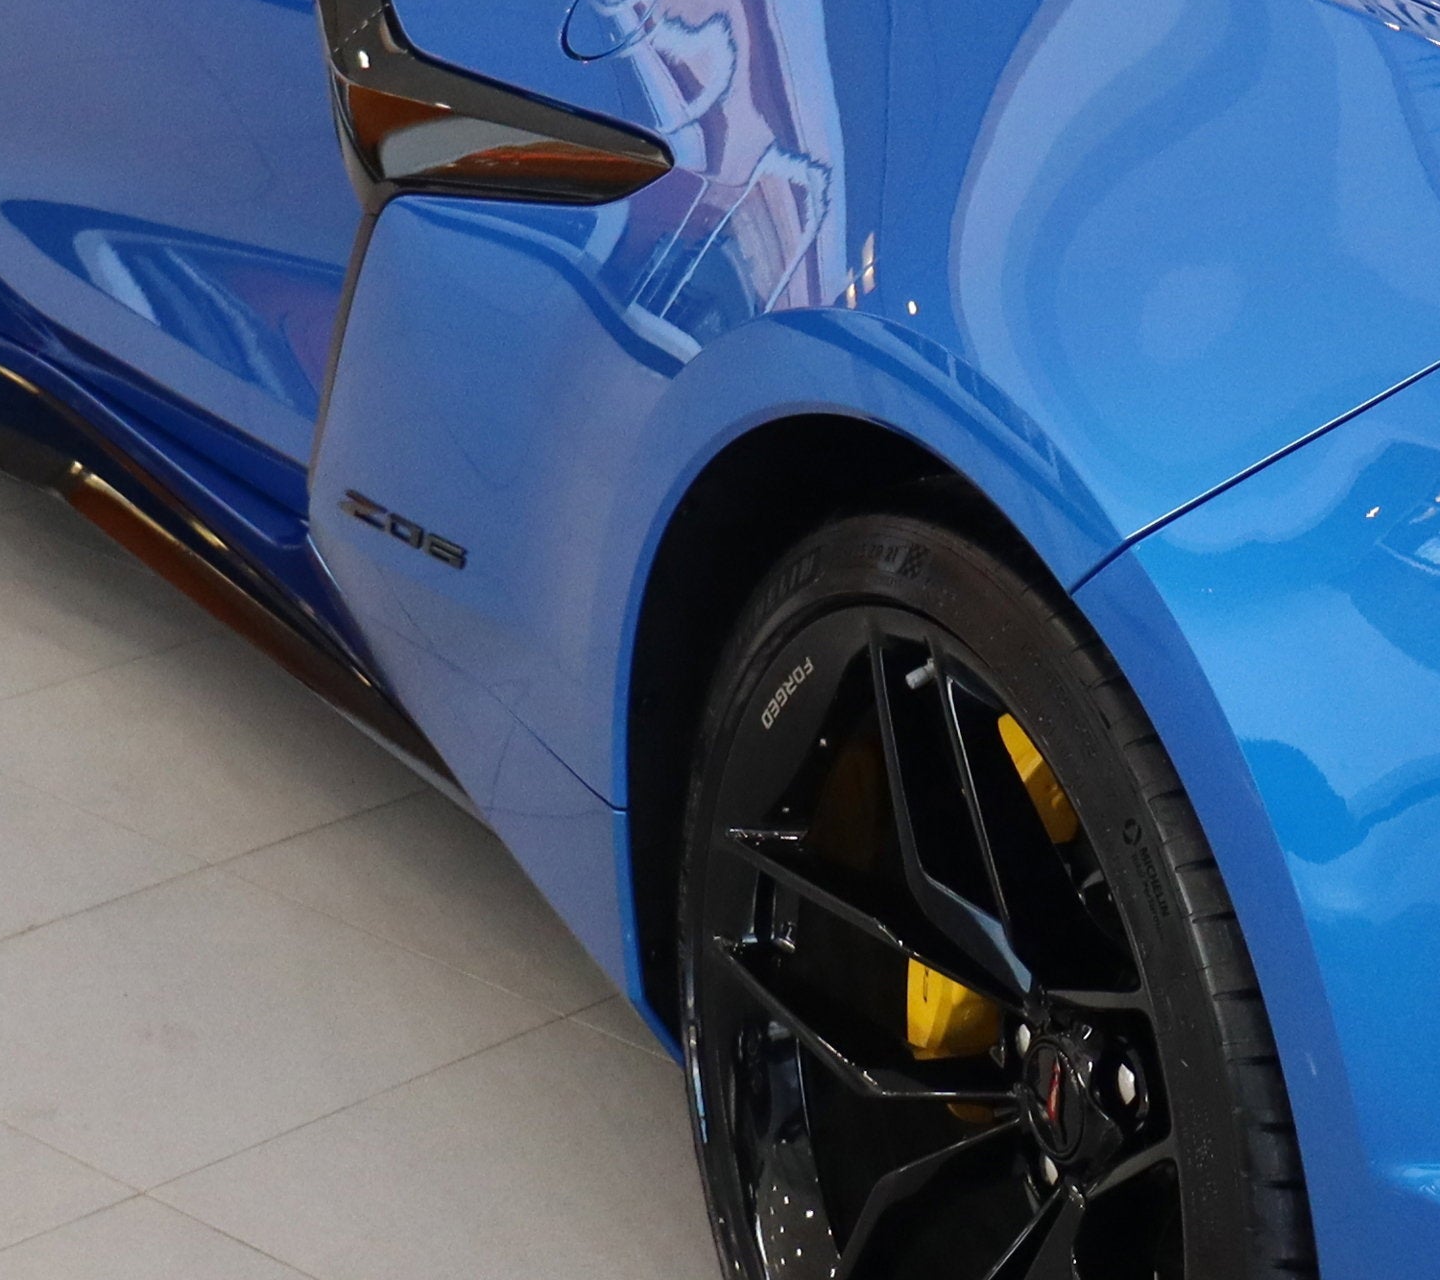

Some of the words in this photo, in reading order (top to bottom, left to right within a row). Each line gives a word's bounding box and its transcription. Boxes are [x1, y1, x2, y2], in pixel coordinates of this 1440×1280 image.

[337, 488, 469, 570] Z06
[760, 656, 815, 731] FORGED
[1139, 846, 1170, 917] MICHELIN
